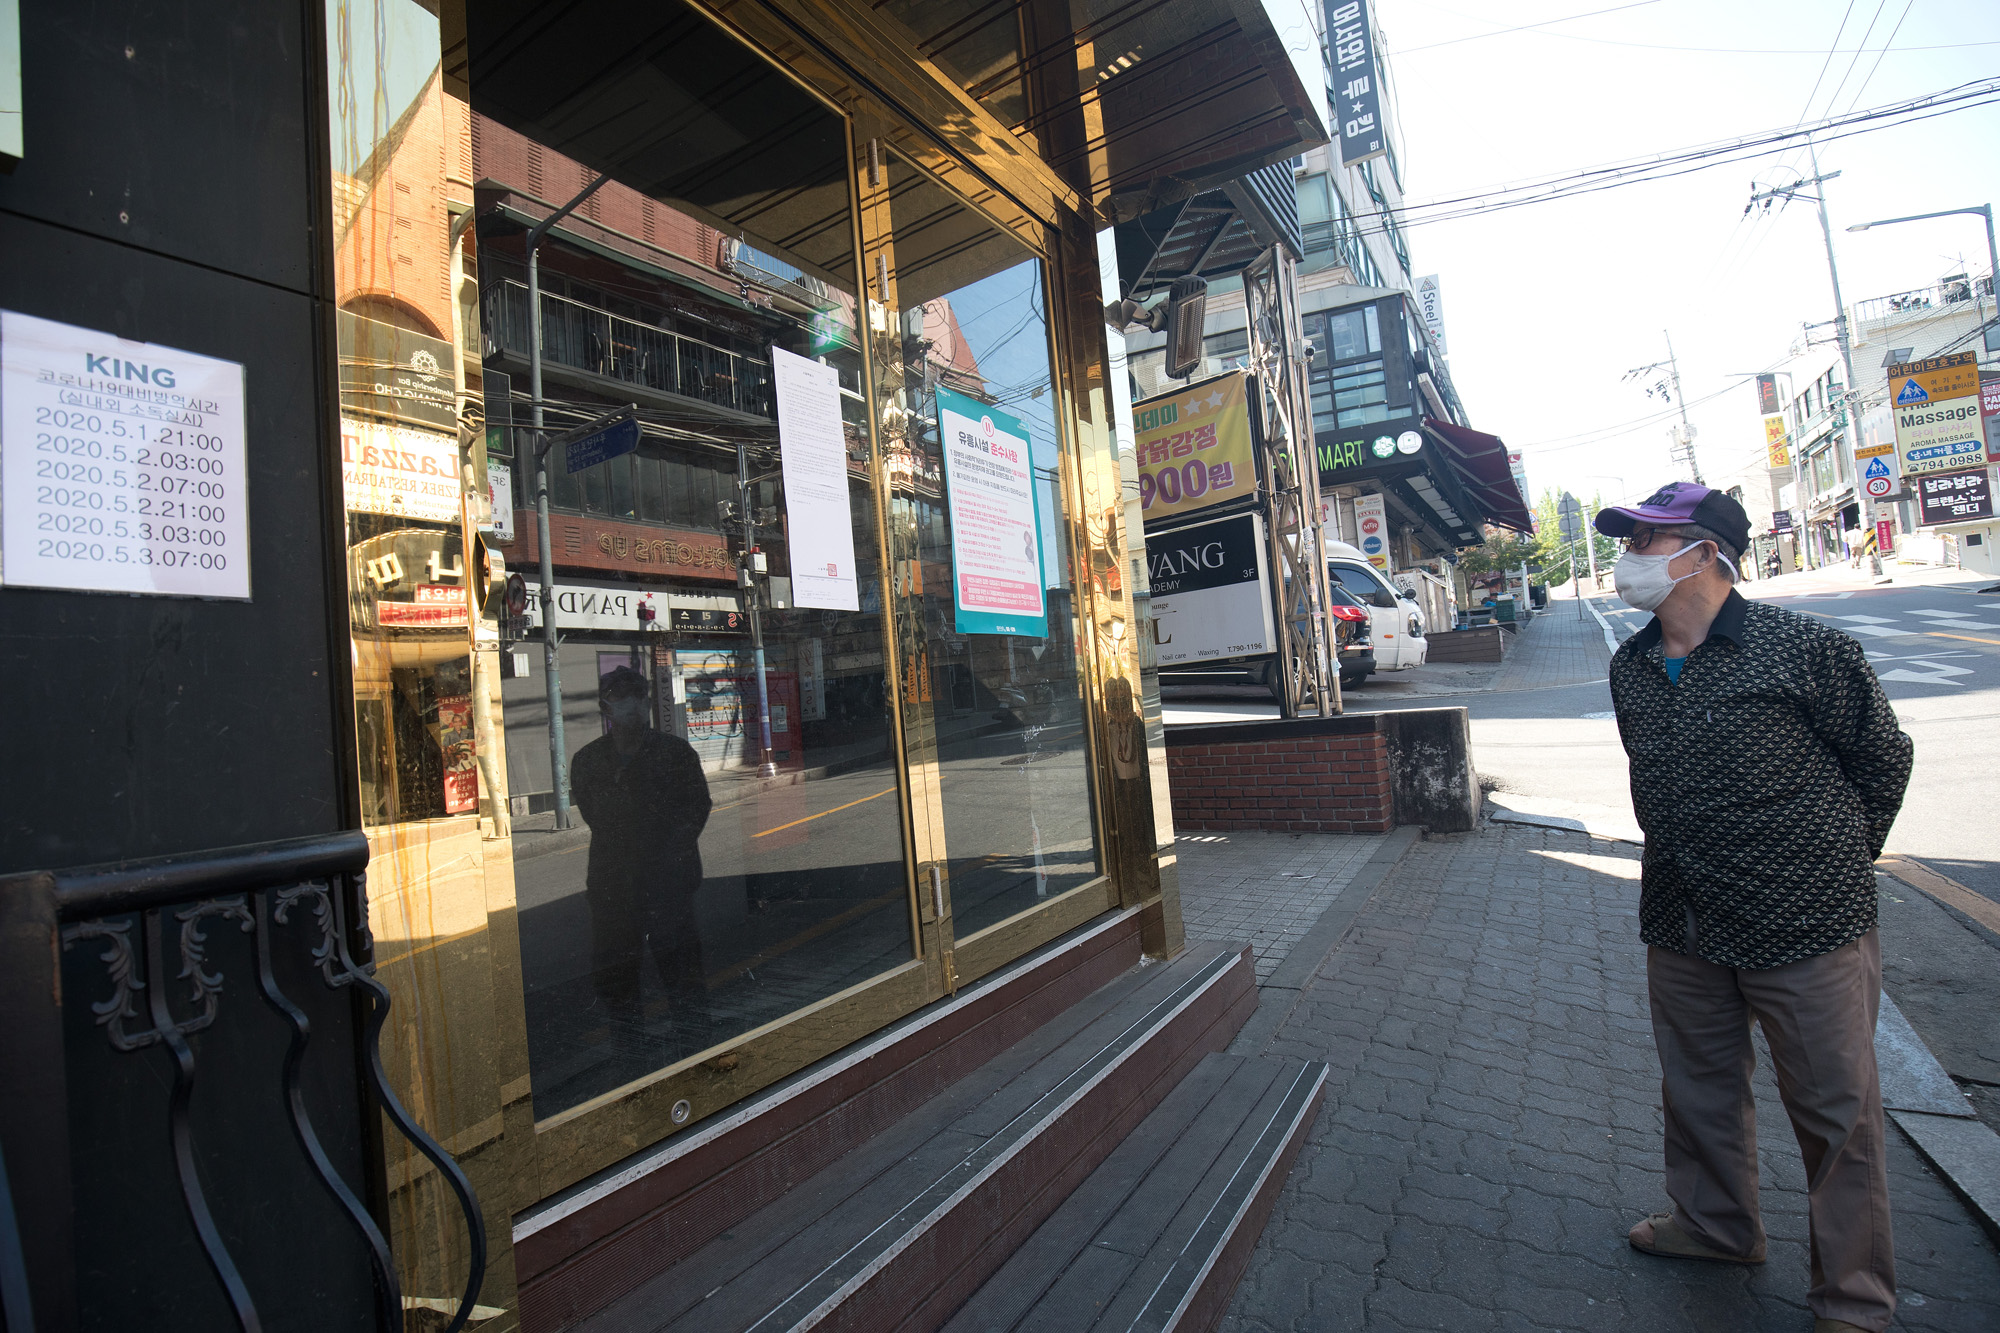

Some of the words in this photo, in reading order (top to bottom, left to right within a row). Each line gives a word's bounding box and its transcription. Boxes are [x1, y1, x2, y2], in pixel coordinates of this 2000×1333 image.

[1370, 140, 1379, 151] B1
[1423, 292, 1438, 322] Steel
[86, 352, 177, 389] KING
[1891, 352, 1974, 376] 어린이보호구역
[58, 389, 121, 413] (실내외
[1983, 394, 2000, 405] PA
[1900, 405, 1978, 429] Massage
[1910, 438, 1937, 448] AROMA
[1938, 431, 1975, 443] MASSAGE
[1911, 428, 1934, 439] 타이
[1938, 421, 1973, 434] 마사지
[36, 433, 224, 476] 2020.5.2.03:00
[958, 431, 989, 453] 유흥시설
[990, 442, 1018, 464] 준수사항
[1318, 440, 1365, 472] MART
[1920, 453, 1983, 471] 794-0988
[36, 459, 225, 500] 2020.5.2.07:00
[1872, 481, 1886, 492] 30
[1925, 475, 1983, 493] 보라보라
[37, 485, 226, 523] 2020.5.2.21:00
[1951, 502, 1980, 516] 젠더
[1970, 494, 1986, 502] bar
[37, 512, 226, 547] 2020.5.3.03:00
[38, 539, 227, 571] 2020.5.3.07:00
[1243, 568, 1255, 578] 3F
[1174, 652, 1187, 660] care
[1197, 648, 1220, 657] Waxing
[1227, 642, 1263, 653] T.790-1196
